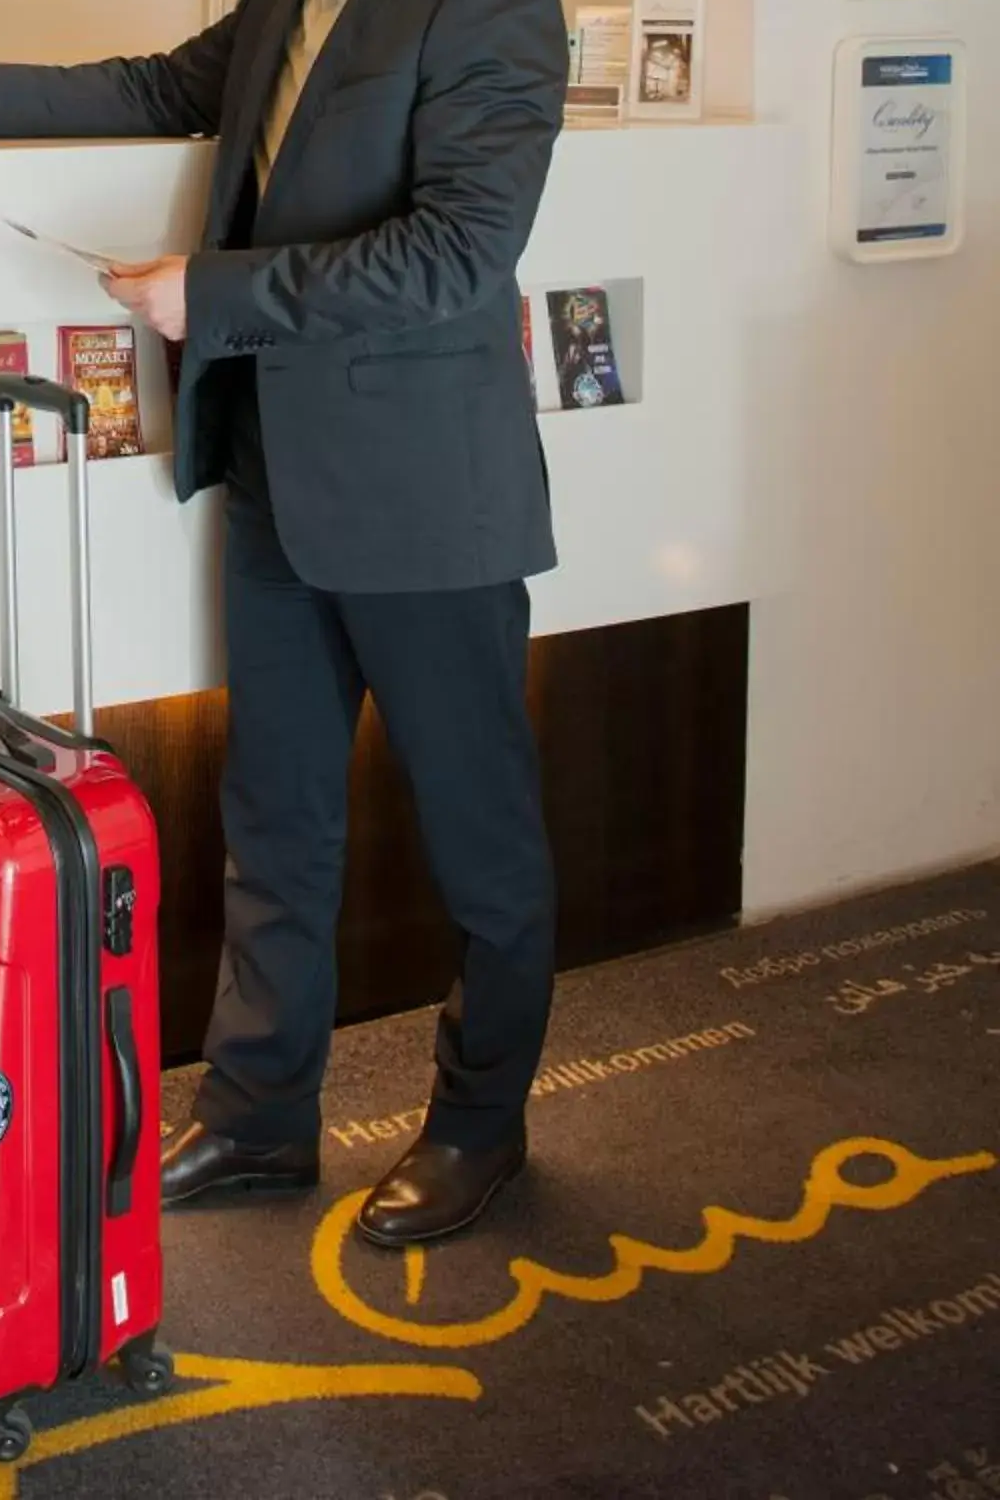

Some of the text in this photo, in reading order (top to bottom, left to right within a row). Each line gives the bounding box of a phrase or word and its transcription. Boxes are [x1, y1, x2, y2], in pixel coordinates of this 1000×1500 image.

[327, 1019, 756, 1148] Herz willkommen
[634, 1272, 1000, 1438] Hartlijk welkom
